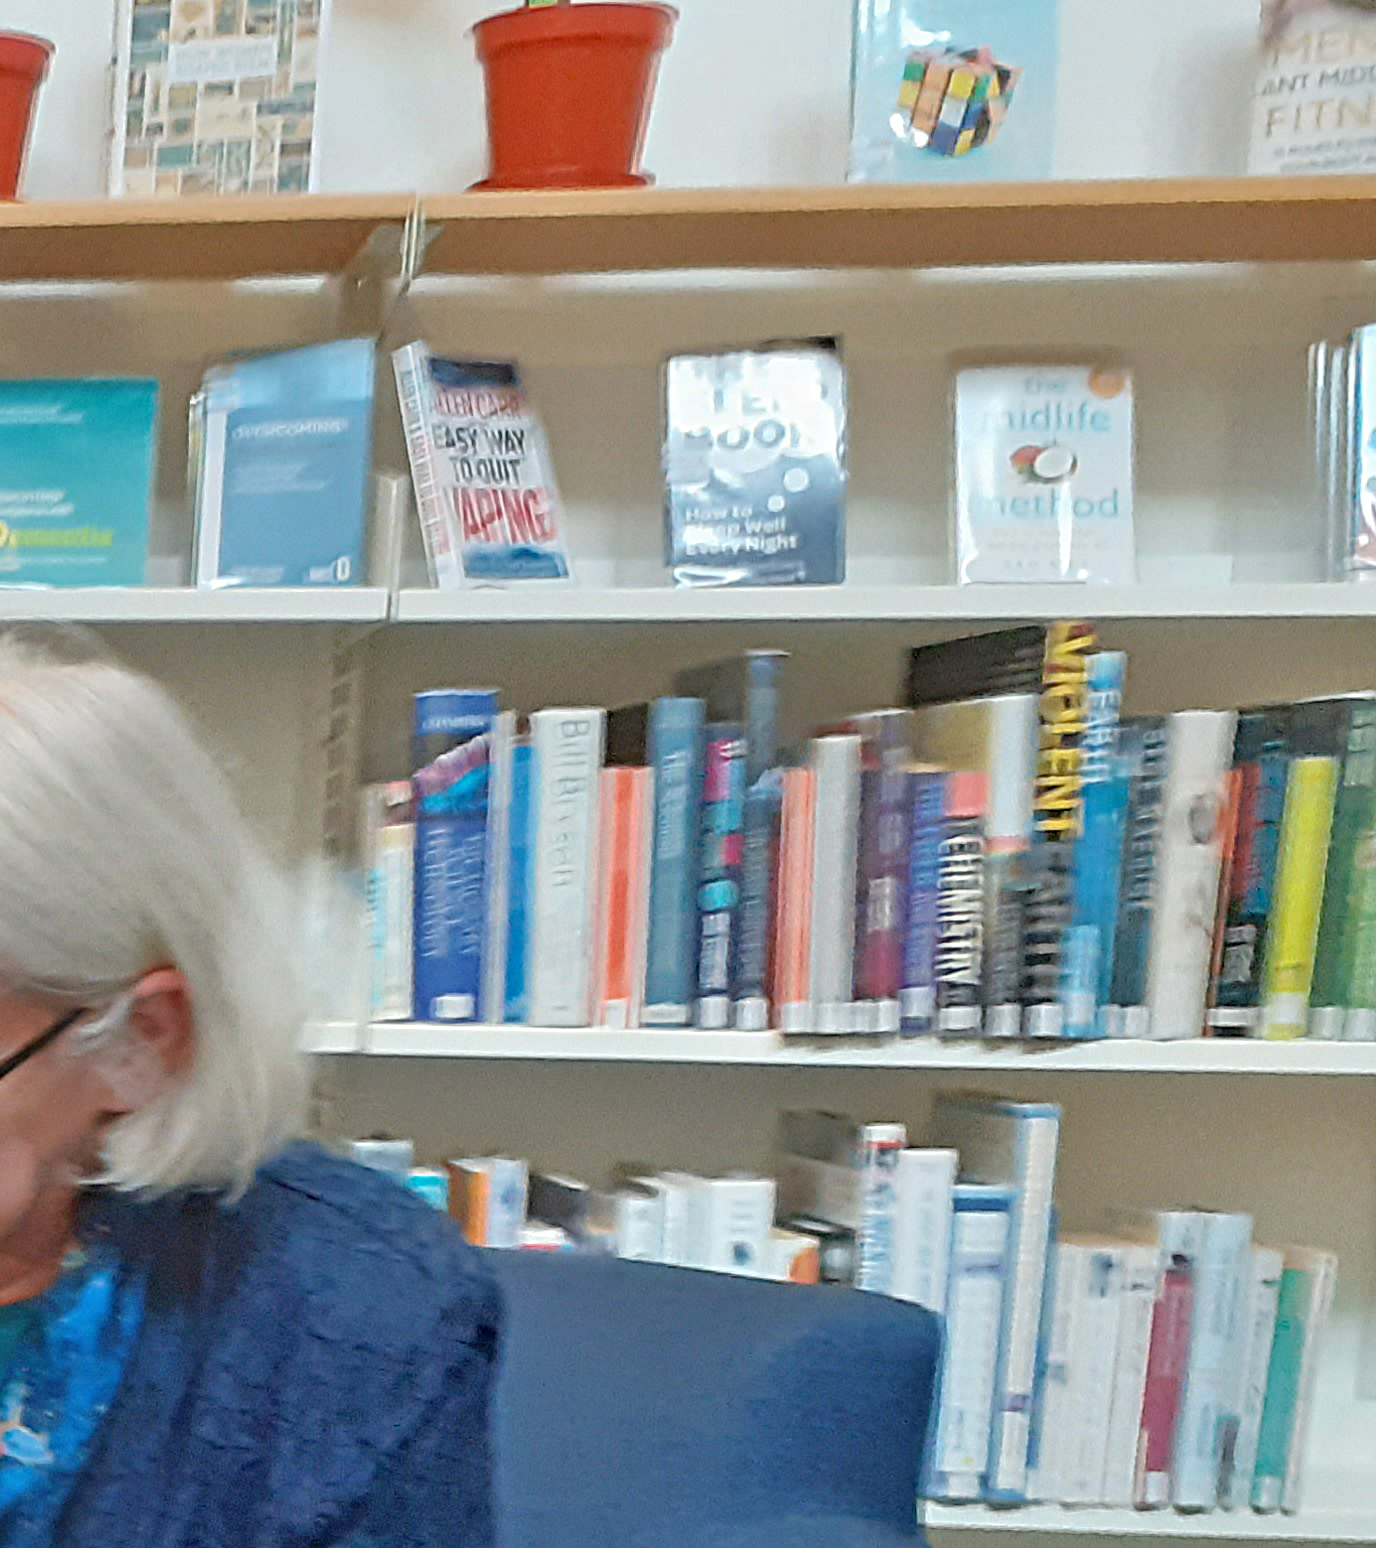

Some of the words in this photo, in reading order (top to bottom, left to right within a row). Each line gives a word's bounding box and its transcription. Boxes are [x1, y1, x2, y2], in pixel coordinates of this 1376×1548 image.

[1261, 72, 1310, 96] ANT
[431, 422, 478, 455] EASY
[484, 427, 528, 457] WAY
[449, 456, 475, 485] TO
[476, 457, 521, 486] QUIT
[685, 506, 728, 521] How
[743, 515, 788, 533] Well
[747, 533, 799, 555] Night
[553, 718, 591, 767] Bill
[1033, 632, 1098, 837] VIOLENT
[552, 777, 587, 889] Bryson
[935, 835, 986, 986] CHEMISTRY
